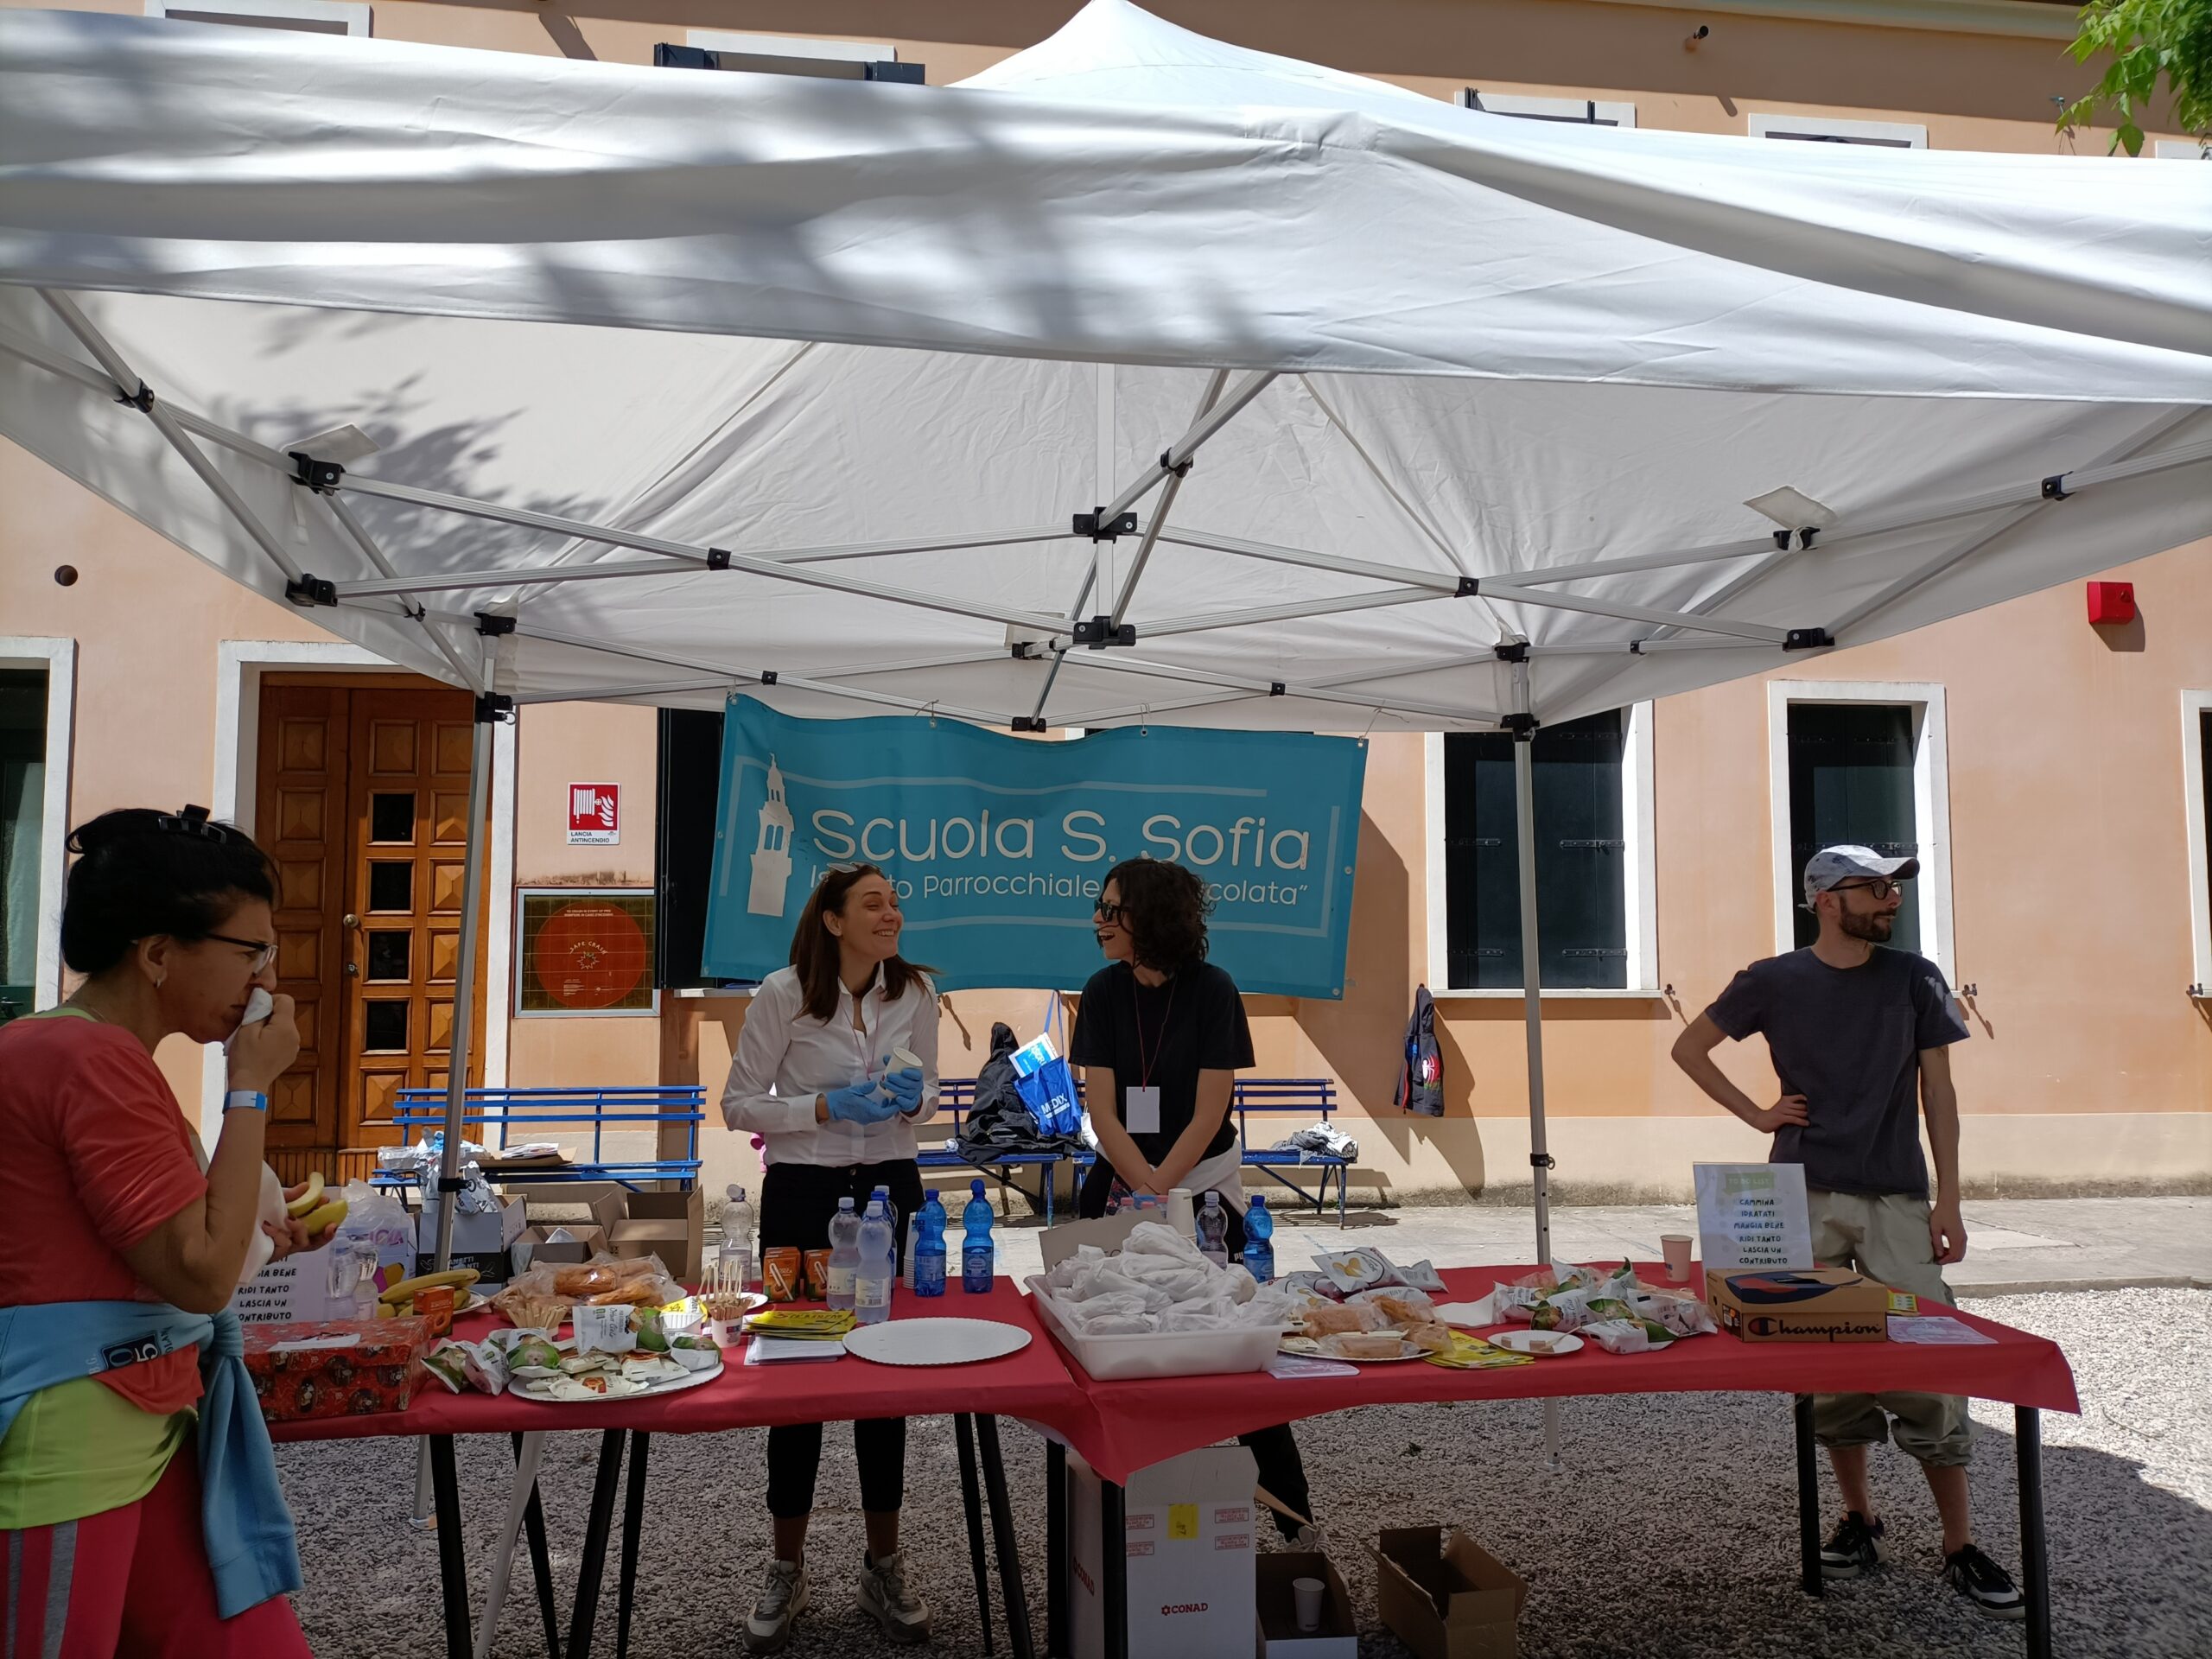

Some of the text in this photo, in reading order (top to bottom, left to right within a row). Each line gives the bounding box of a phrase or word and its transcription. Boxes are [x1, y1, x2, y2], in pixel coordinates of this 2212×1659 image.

[811, 809, 1310, 871] Scuola S. Sofia
[923, 872, 1101, 900] Parrocchiale
[272, 1268, 297, 1278] BENE
[238, 1285, 290, 1295] RIDI TANTO
[239, 1299, 287, 1308] LASCIA UN
[238, 1312, 292, 1323] ONTRIBUTO
[1747, 1317, 1882, 1343] Champion
[1077, 1562, 1095, 1598] CONAD
[1171, 1603, 1209, 1614] CONAD
